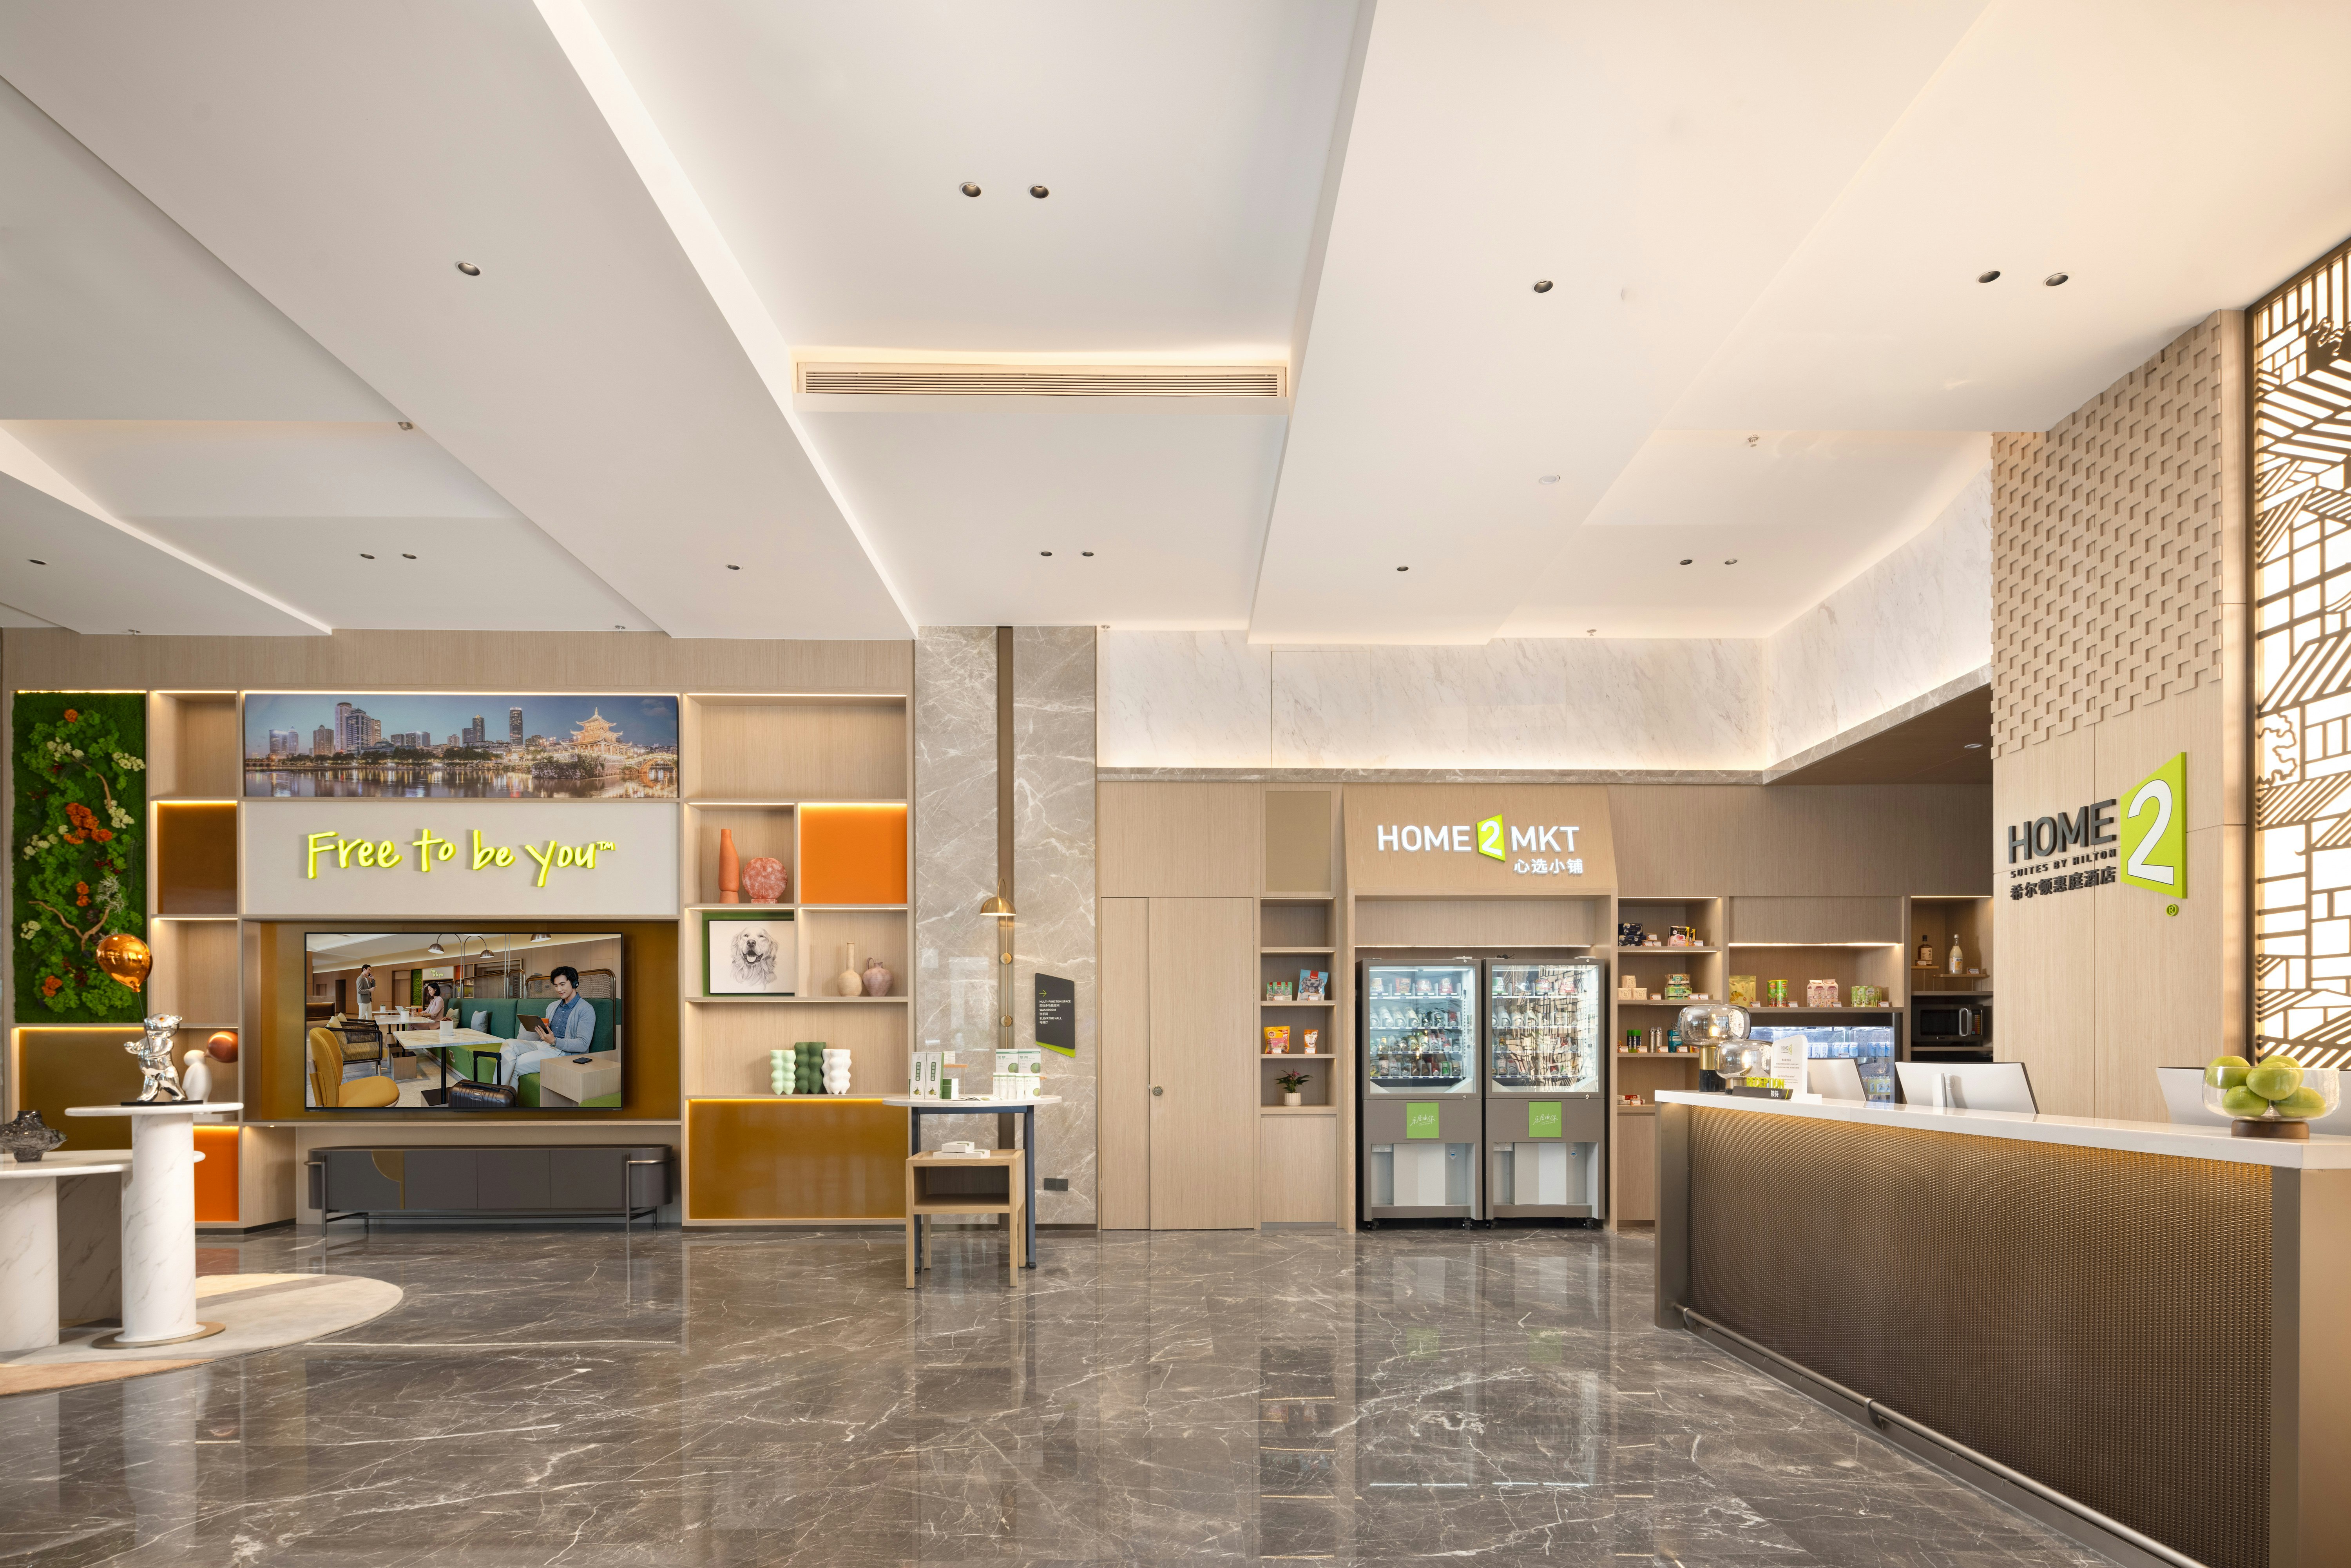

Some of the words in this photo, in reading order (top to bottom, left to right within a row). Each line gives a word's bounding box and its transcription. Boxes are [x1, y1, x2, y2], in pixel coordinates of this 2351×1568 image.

[1377, 825, 1471, 852] HOME
[1481, 820, 1503, 857] 2
[1510, 826, 1579, 852] MKT
[2009, 799, 2117, 864] HOME
[2127, 779, 2174, 885] 2
[308, 831, 402, 879] Free
[412, 829, 456, 872] to
[473, 829, 515, 871] be
[1513, 858, 1583, 875] 心选小铺
[2010, 864, 2048, 878] SUITES
[2053, 860, 2067, 869] BY
[2072, 848, 2117, 865] HILTON
[2010, 866, 2116, 900] 希尔顿惠庭酒店
[1746, 1077, 1784, 1089] RECEPTION
